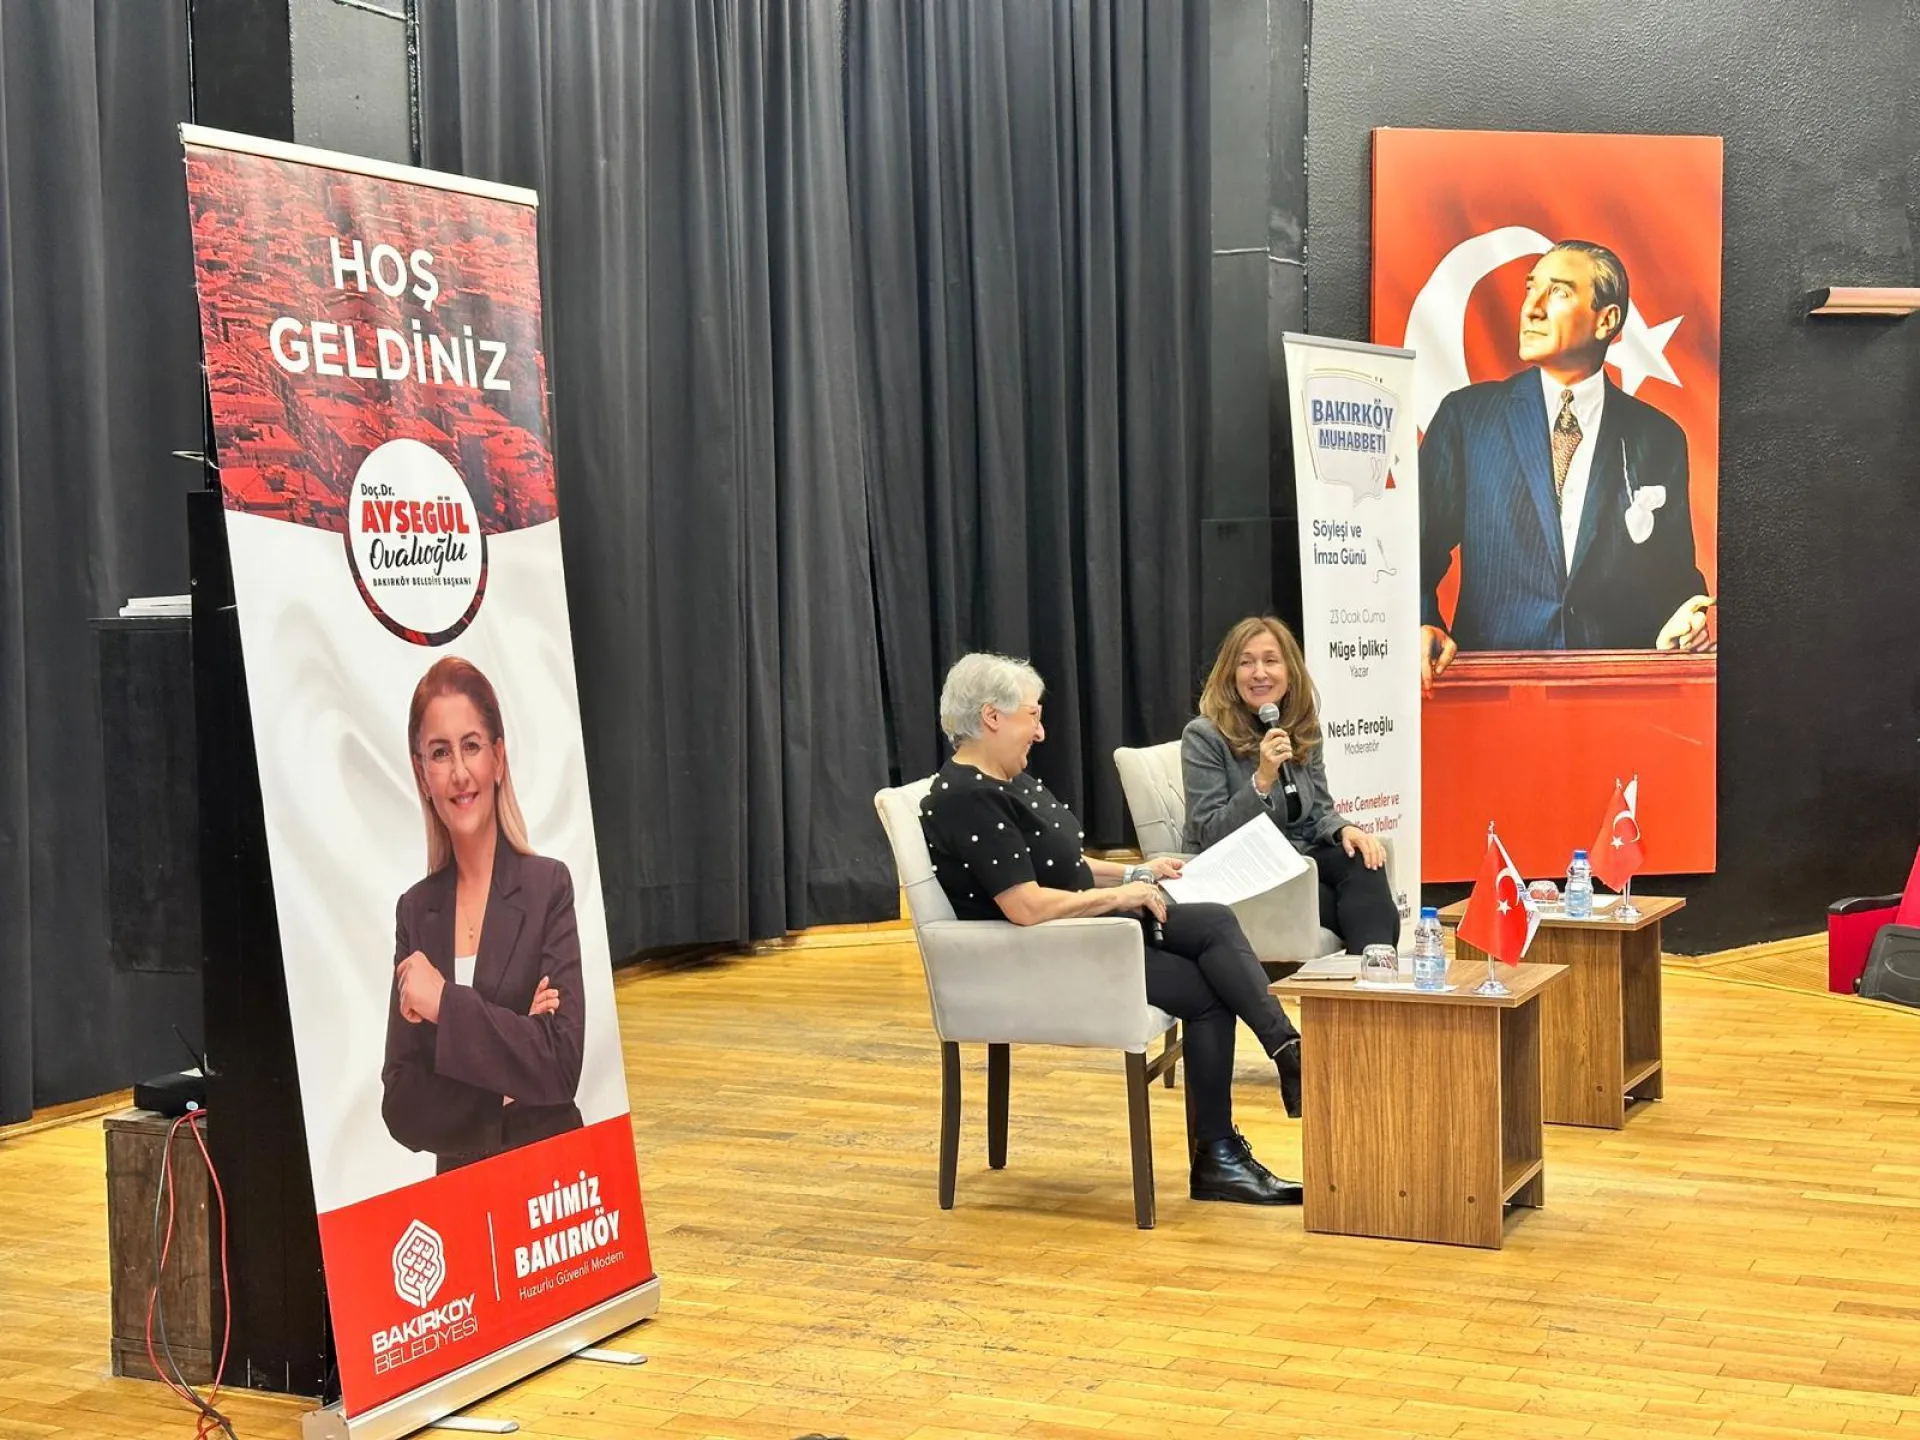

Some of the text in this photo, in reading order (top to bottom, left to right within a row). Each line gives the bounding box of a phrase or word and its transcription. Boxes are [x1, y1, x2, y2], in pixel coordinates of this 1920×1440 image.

[329, 236, 439, 312] HOŞ
[269, 316, 511, 391] GELDİNİZ
[1311, 399, 1394, 431] BAKIRKÖY
[1318, 428, 1387, 454] MUHABBETİ
[360, 483, 395, 499] Doç.Dr.
[361, 496, 470, 540] AYŞEGÜL
[1313, 519, 1362, 542] Söyleşi ve
[369, 533, 468, 576] Ovalıoğlu
[1313, 543, 1367, 566] İmza Günü
[373, 576, 472, 588] BAKIRKÖY BELEDİYE BAŞKANI
[1330, 608, 1386, 624] 23 Ocak Cuma
[1329, 636, 1388, 661] Müge İplikçi
[1350, 665, 1369, 678] Yazar
[1328, 716, 1393, 738] Necla Feroğlu
[1344, 740, 1380, 756] Moderatör
[1354, 792, 1390, 811] Cennetler
[1391, 794, 1400, 806] ve
[527, 1170, 602, 1230] EVİMİZ
[514, 1206, 620, 1279] BAKIRKÖY
[519, 1250, 625, 1301] Huzurlu Güvenli Modern
[371, 1293, 475, 1354] BAKIRKÖY
